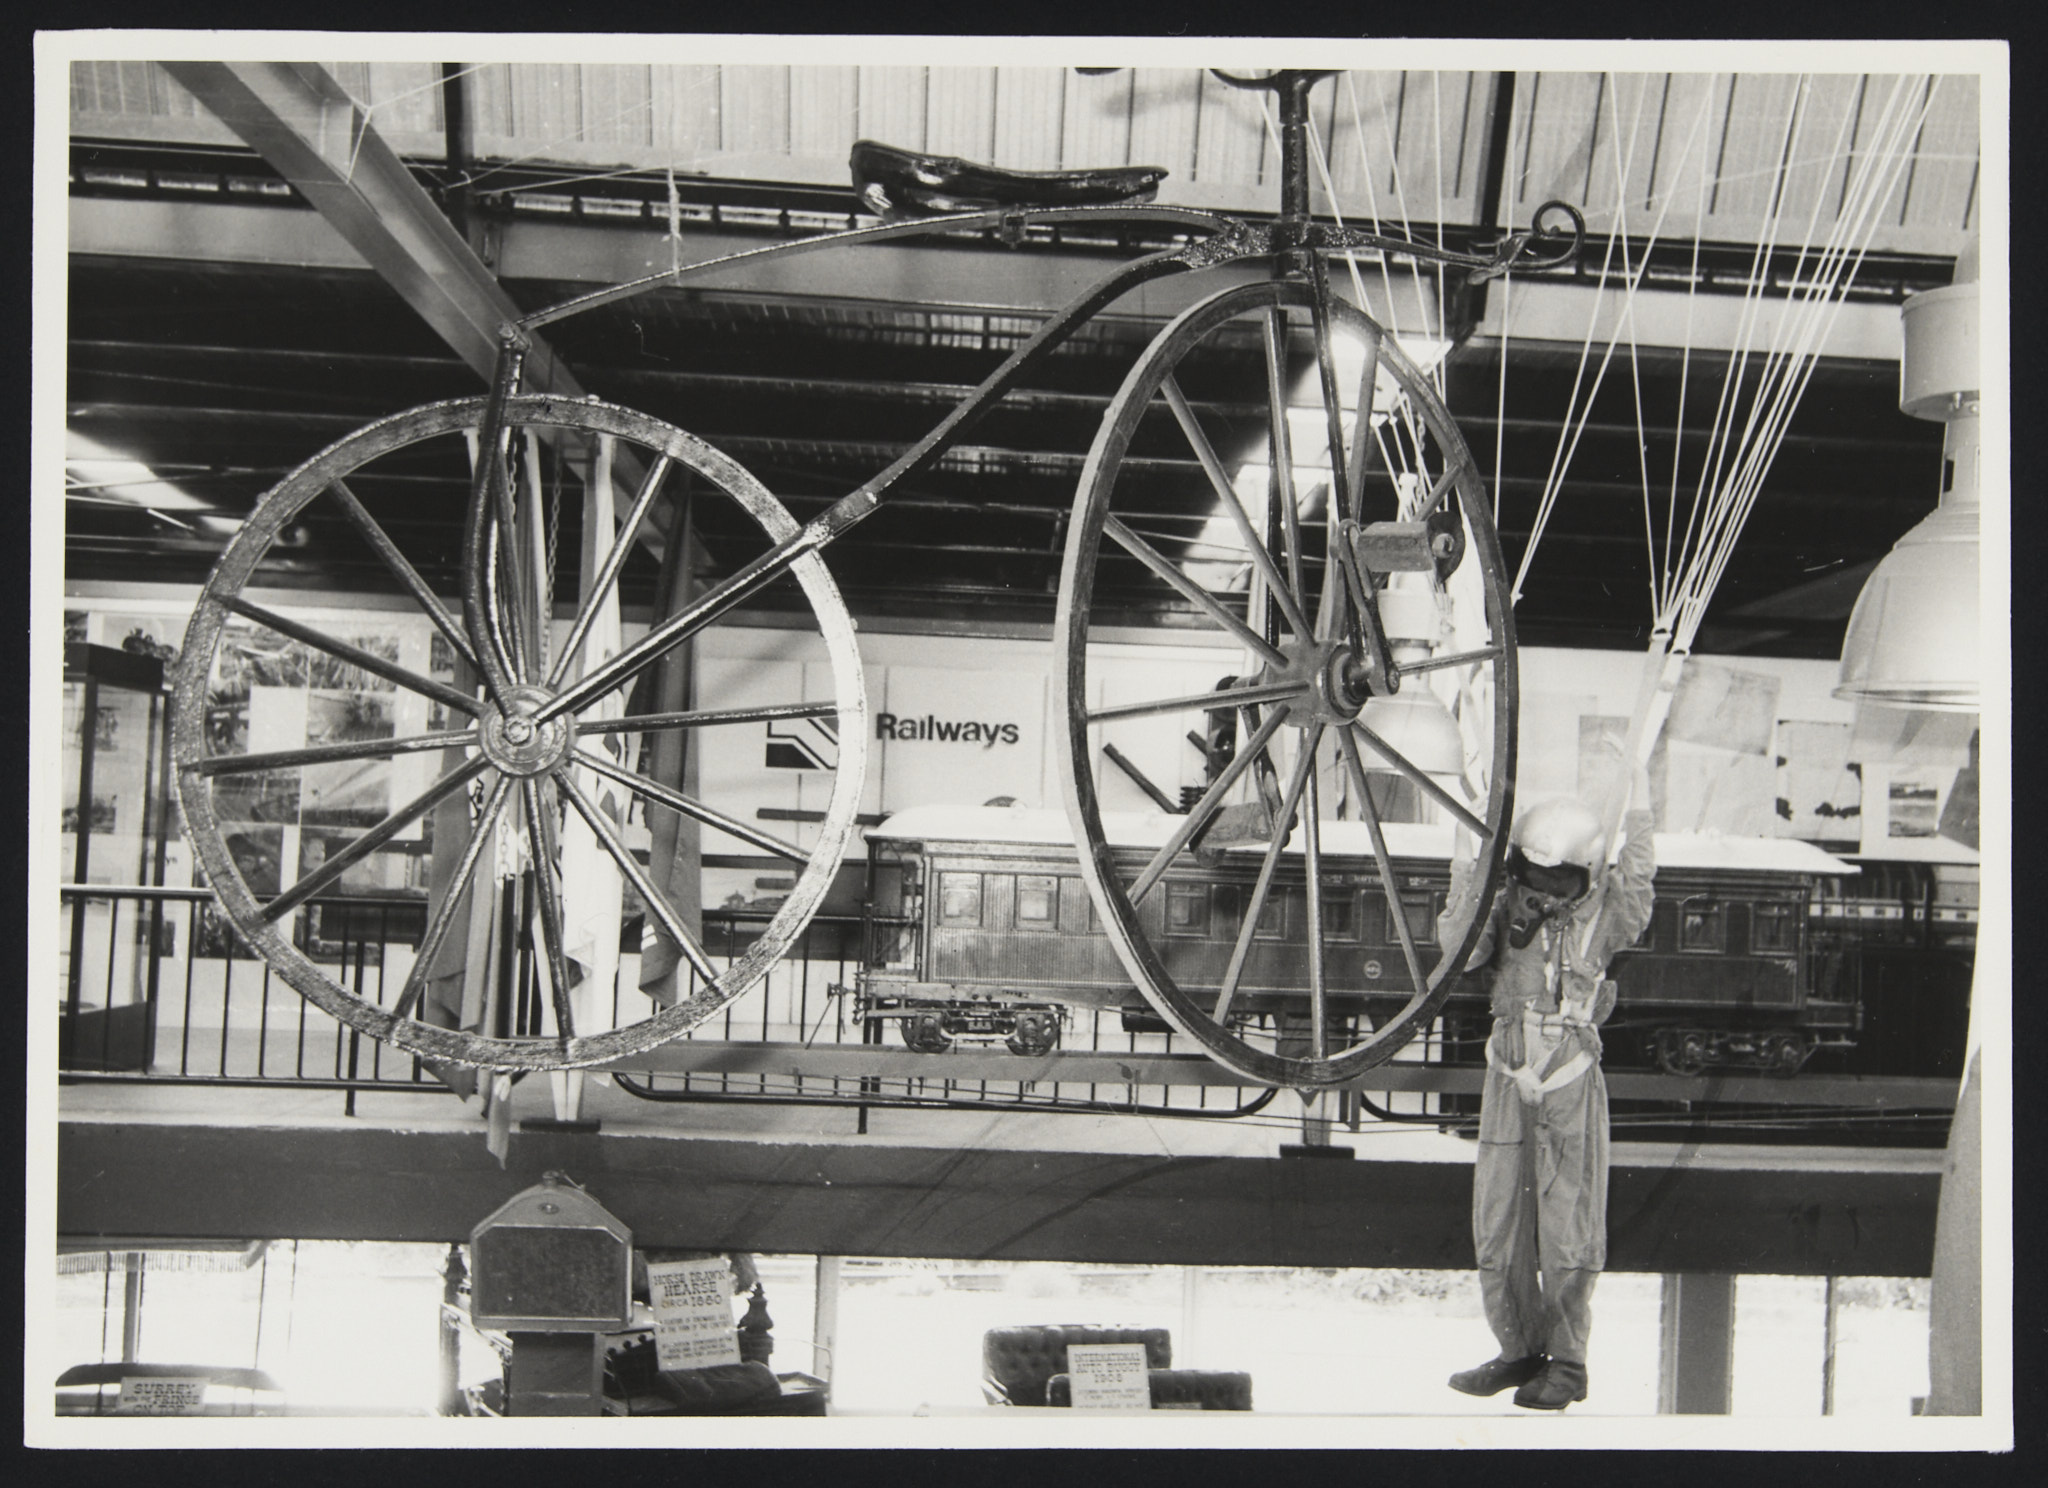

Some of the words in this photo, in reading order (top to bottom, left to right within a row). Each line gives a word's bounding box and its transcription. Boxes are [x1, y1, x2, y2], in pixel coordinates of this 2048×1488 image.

[876, 712, 1019, 750] Railways
[653, 1273, 685, 1286] HORSE
[689, 1269, 725, 1282] DRAWN
[664, 1281, 718, 1297] HEARSE
[134, 1383, 196, 1394] SURREY
[153, 1394, 200, 1405] FRINGE
